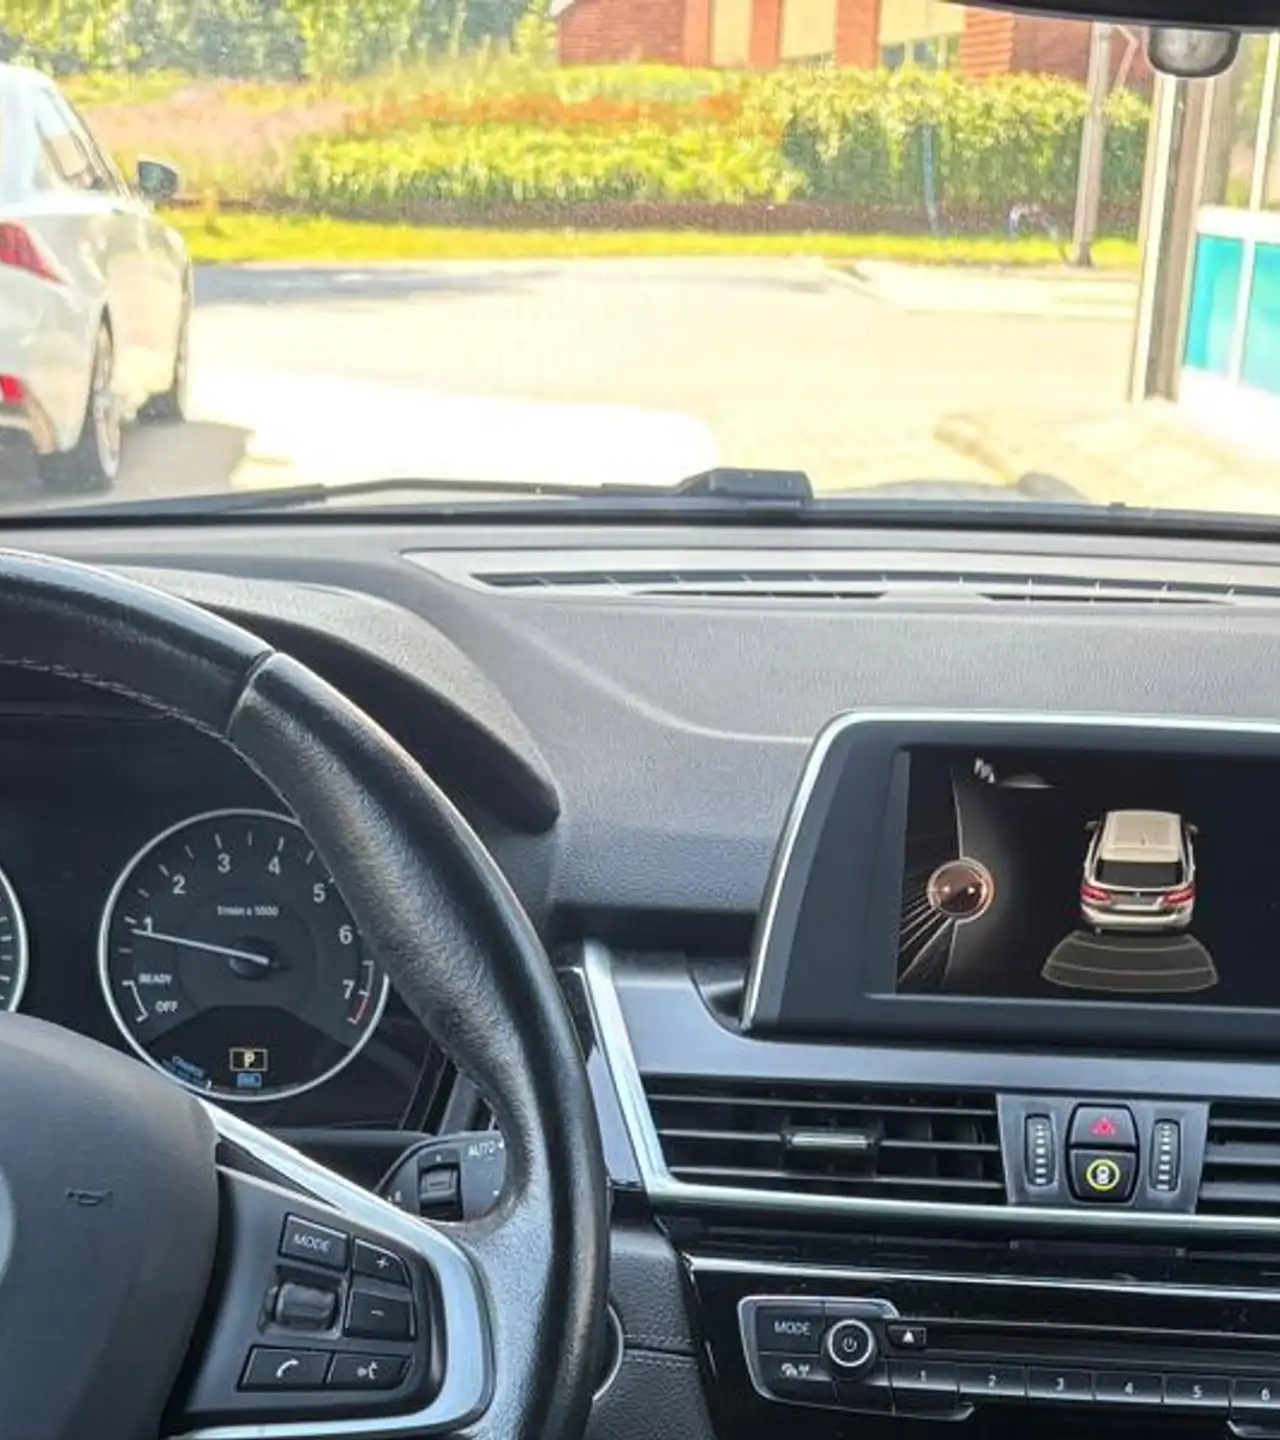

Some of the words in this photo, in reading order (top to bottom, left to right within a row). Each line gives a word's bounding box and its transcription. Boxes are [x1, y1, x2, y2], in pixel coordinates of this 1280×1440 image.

[217, 853, 231, 873] 3
[268, 856, 281, 875] 4
[172, 874, 186, 894] 2
[313, 883, 326, 902] 5
[144, 917, 154, 934] 1
[339, 925, 352, 944] 6
[342, 980, 355, 999] 7
[155, 1001, 178, 1012] OFF
[243, 1050, 255, 1068] P
[468, 1140, 496, 1156] AUTO
[293, 1233, 331, 1253] MODE
[774, 1320, 812, 1336] MODE
